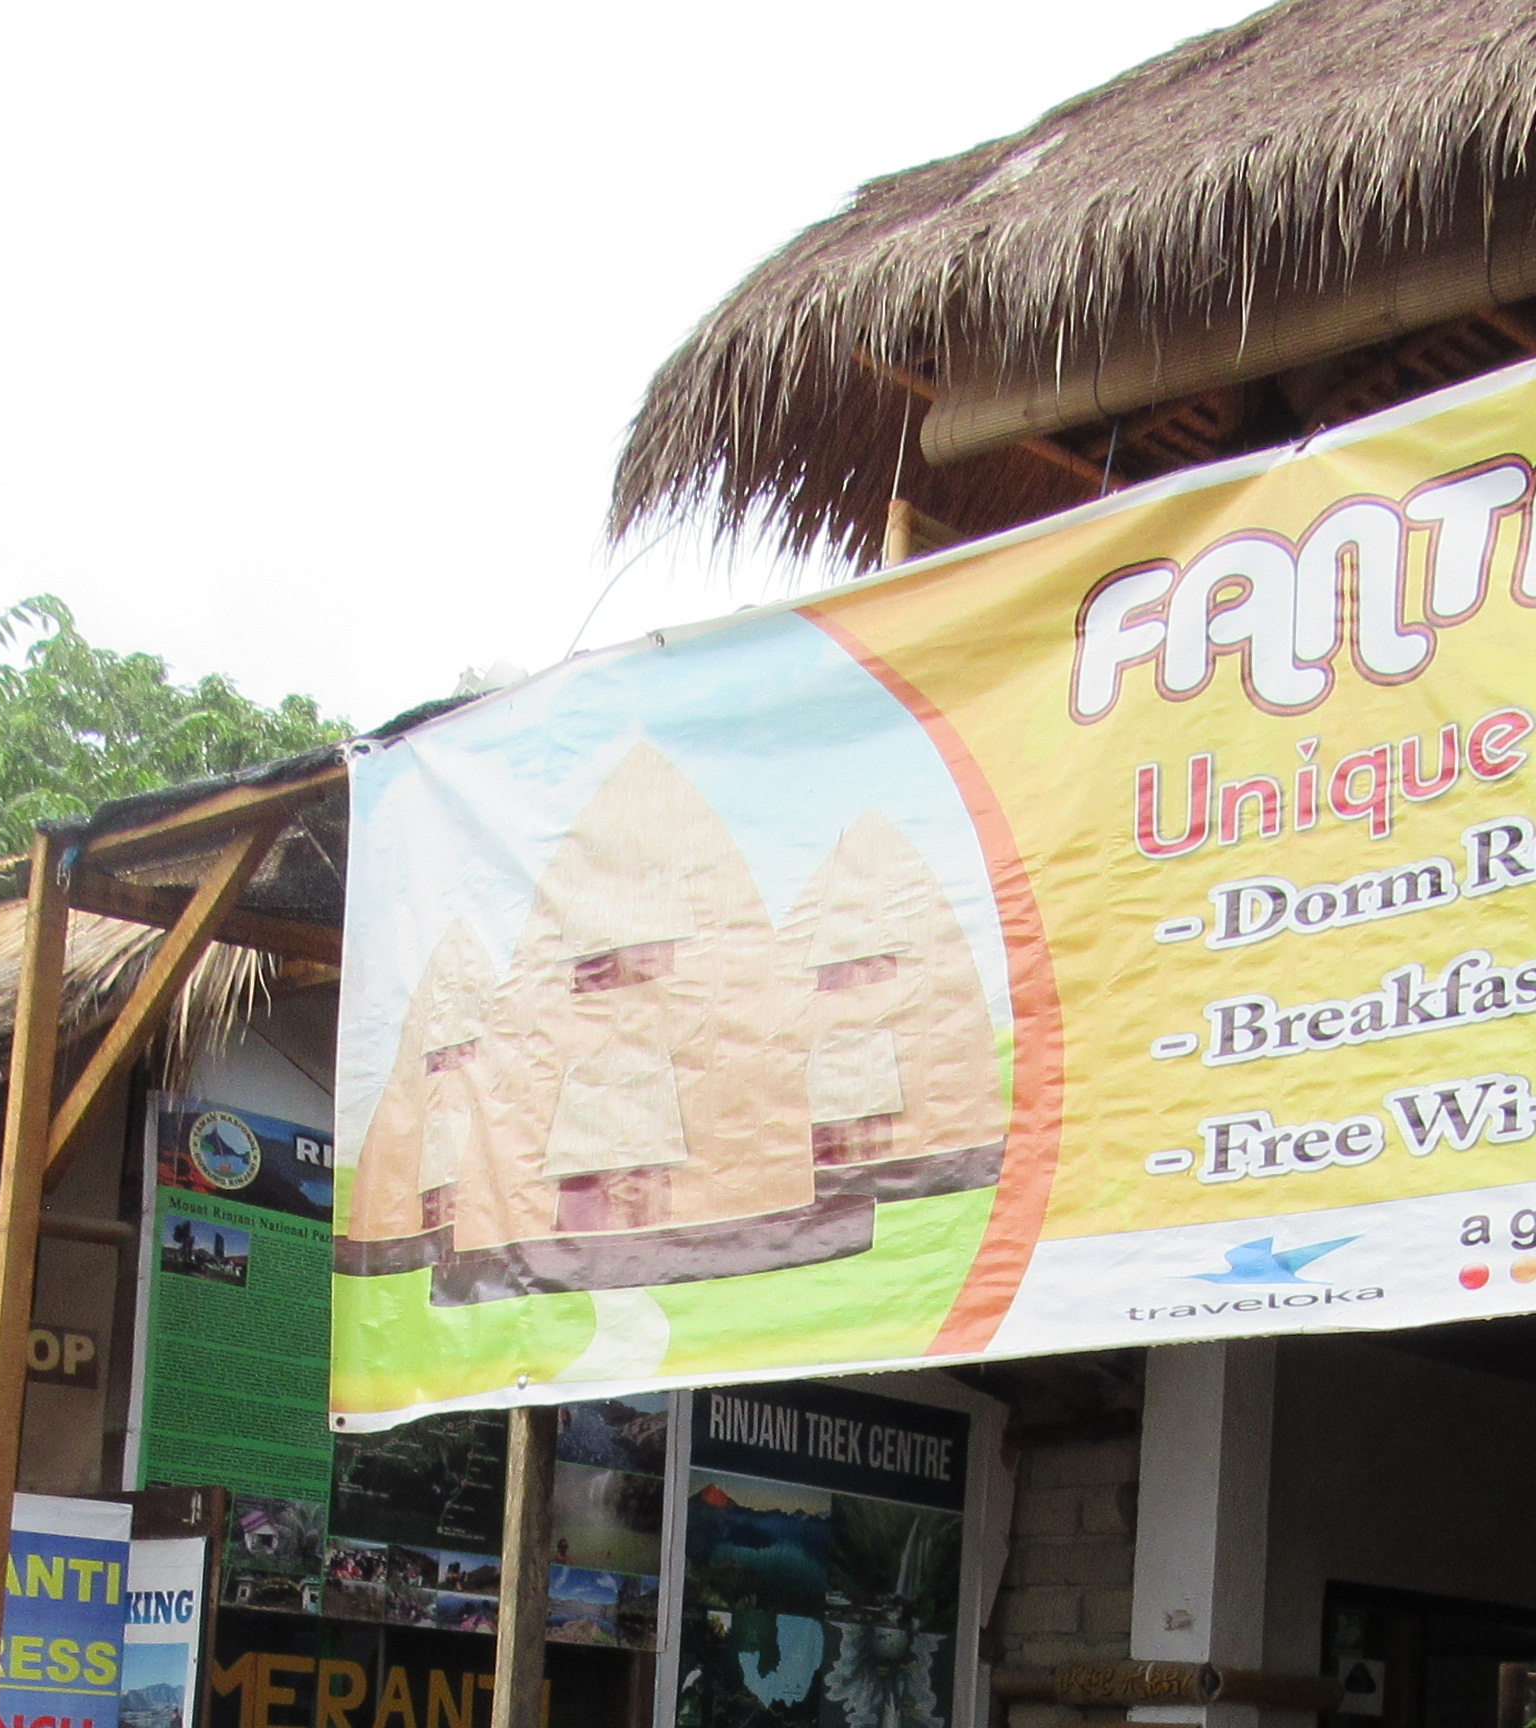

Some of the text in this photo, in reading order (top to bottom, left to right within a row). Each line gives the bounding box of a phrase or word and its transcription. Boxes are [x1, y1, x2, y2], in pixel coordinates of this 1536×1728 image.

[1135, 708, 1534, 859] Unique
[1215, 860, 1448, 944] Dorm
[1206, 1118, 1376, 1177] Free
[170, 1196, 332, 1243] Mount Rinjani National Par
[1126, 1285, 1386, 1322] traveloka
[710, 1393, 953, 1481] RINJANI TREK CENTRE
